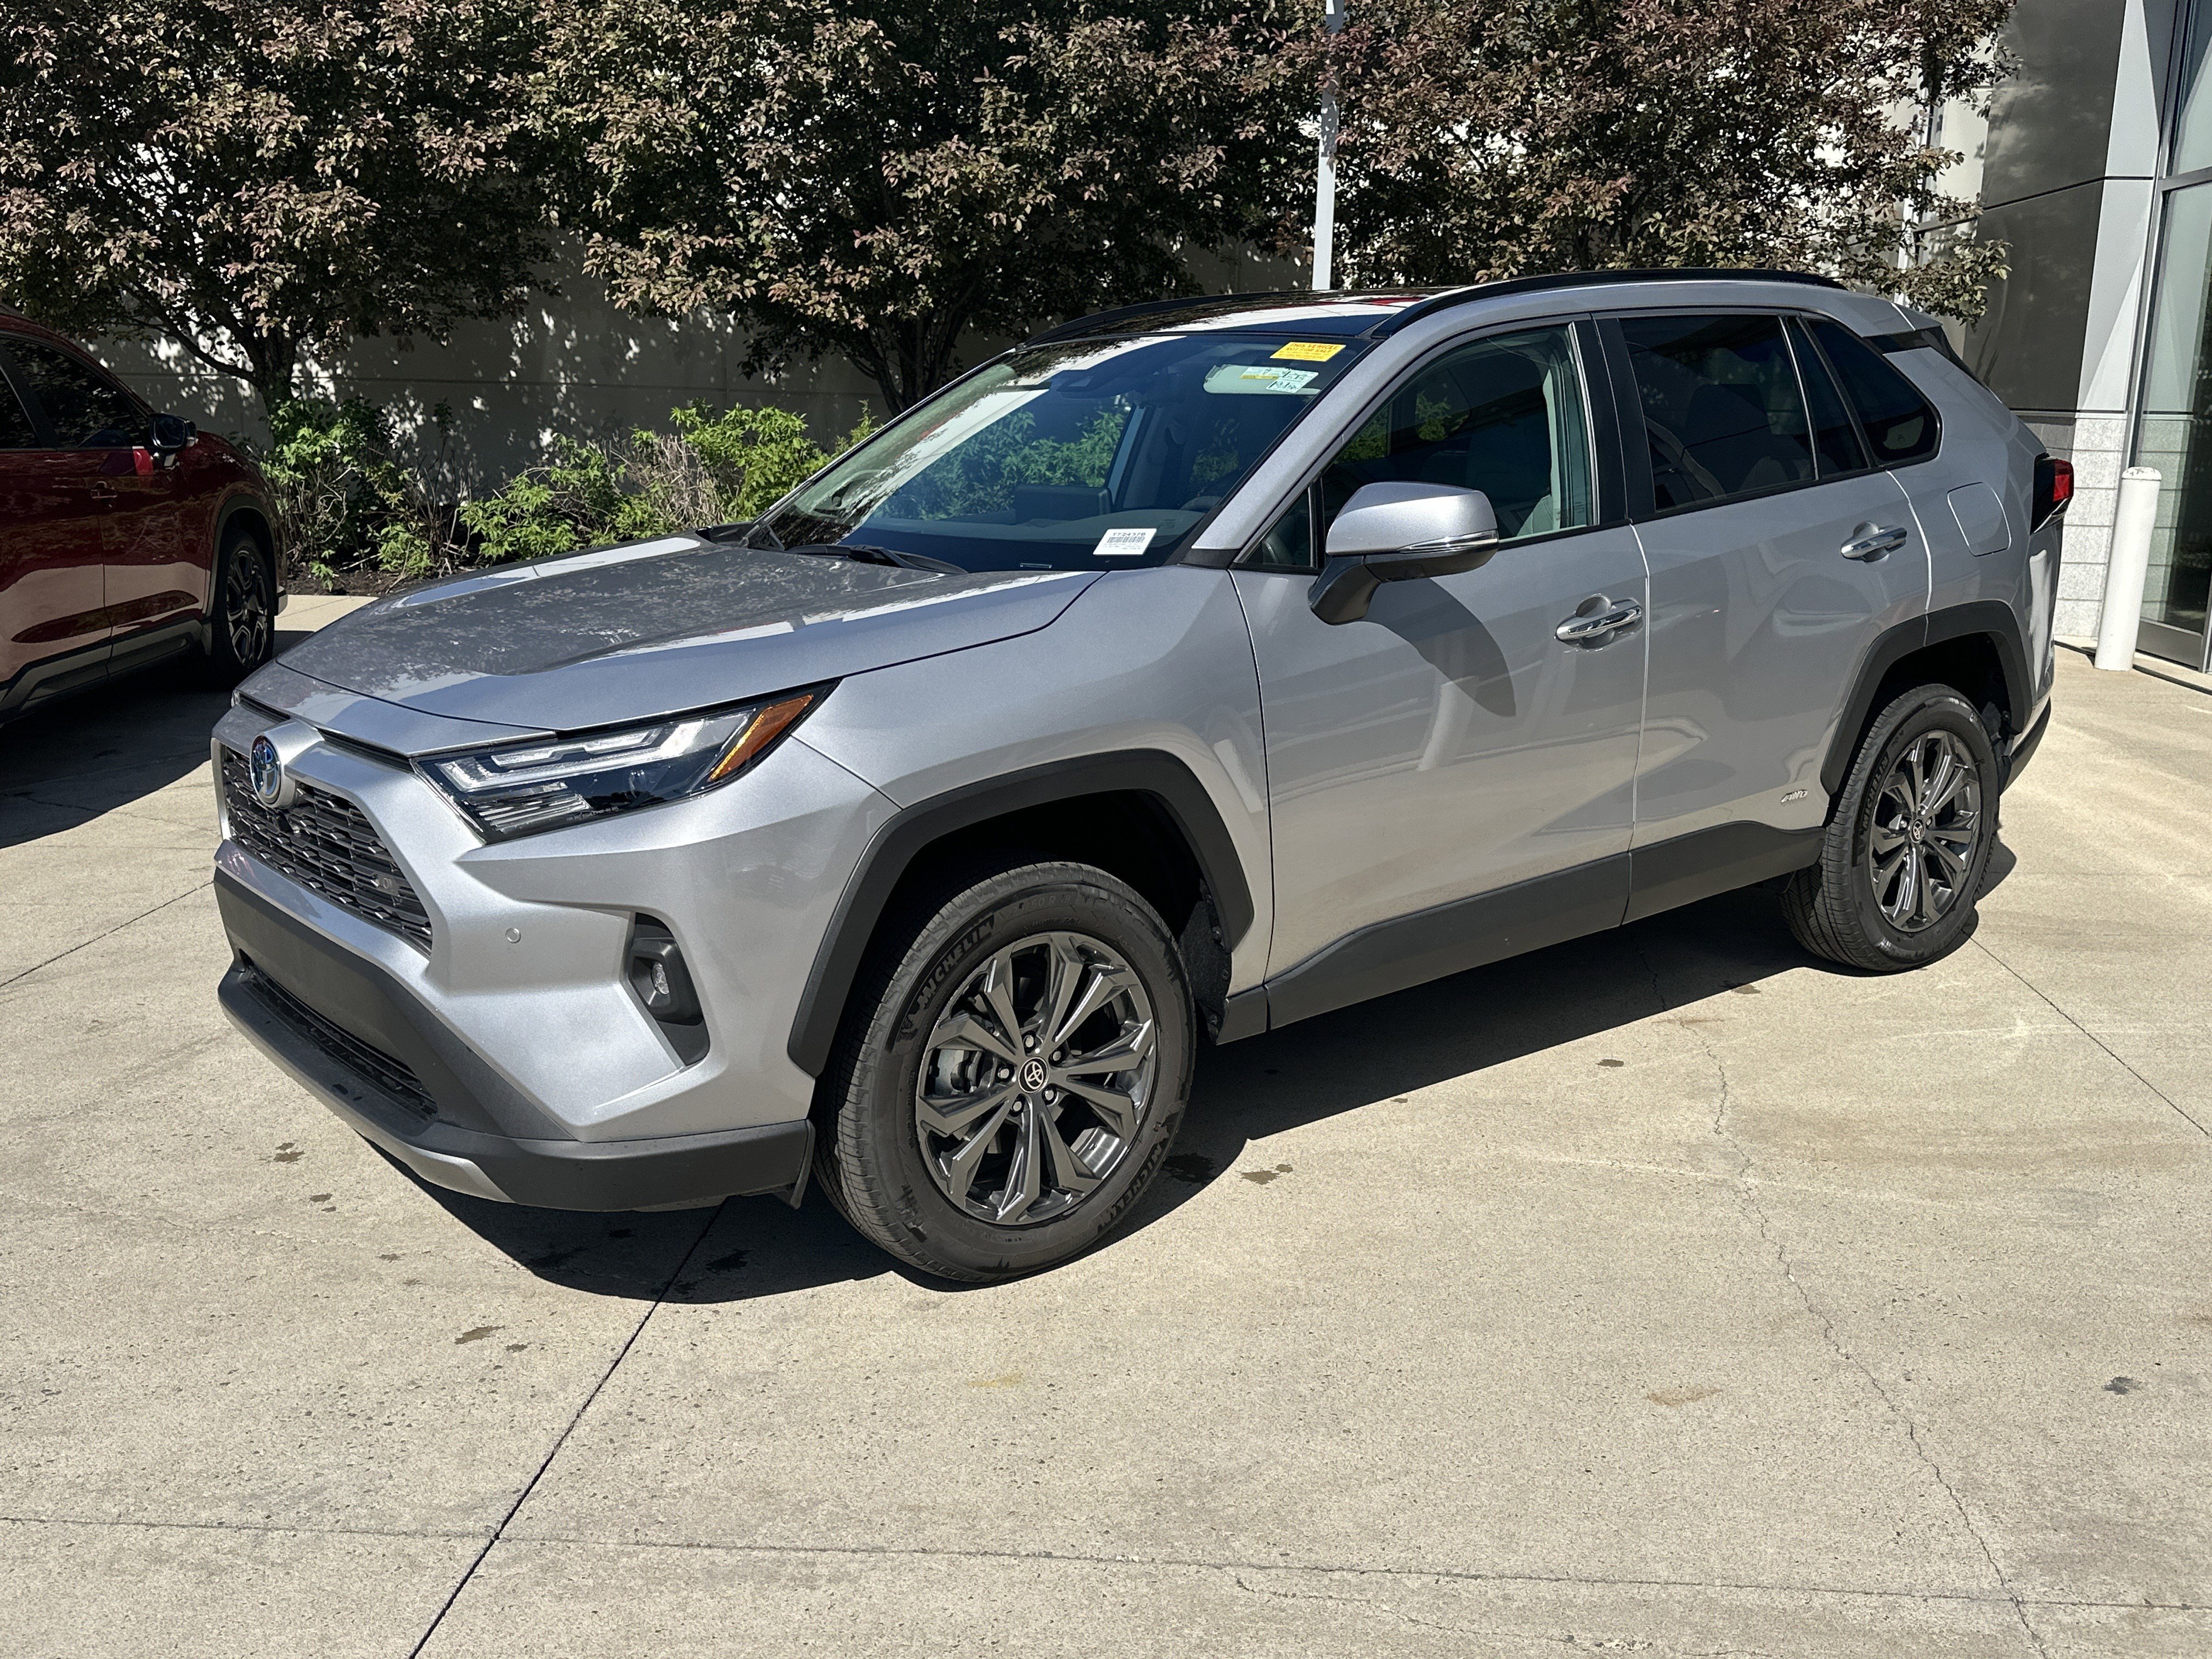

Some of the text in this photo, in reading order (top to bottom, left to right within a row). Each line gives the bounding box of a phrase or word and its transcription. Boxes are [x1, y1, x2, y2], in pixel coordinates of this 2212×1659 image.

[1781, 790, 1808, 802] AWD
[1863, 756, 1889, 829] MICHELIN
[917, 919, 994, 1009] MICHELIN
[1098, 1143, 1162, 1228] MICHELIN
